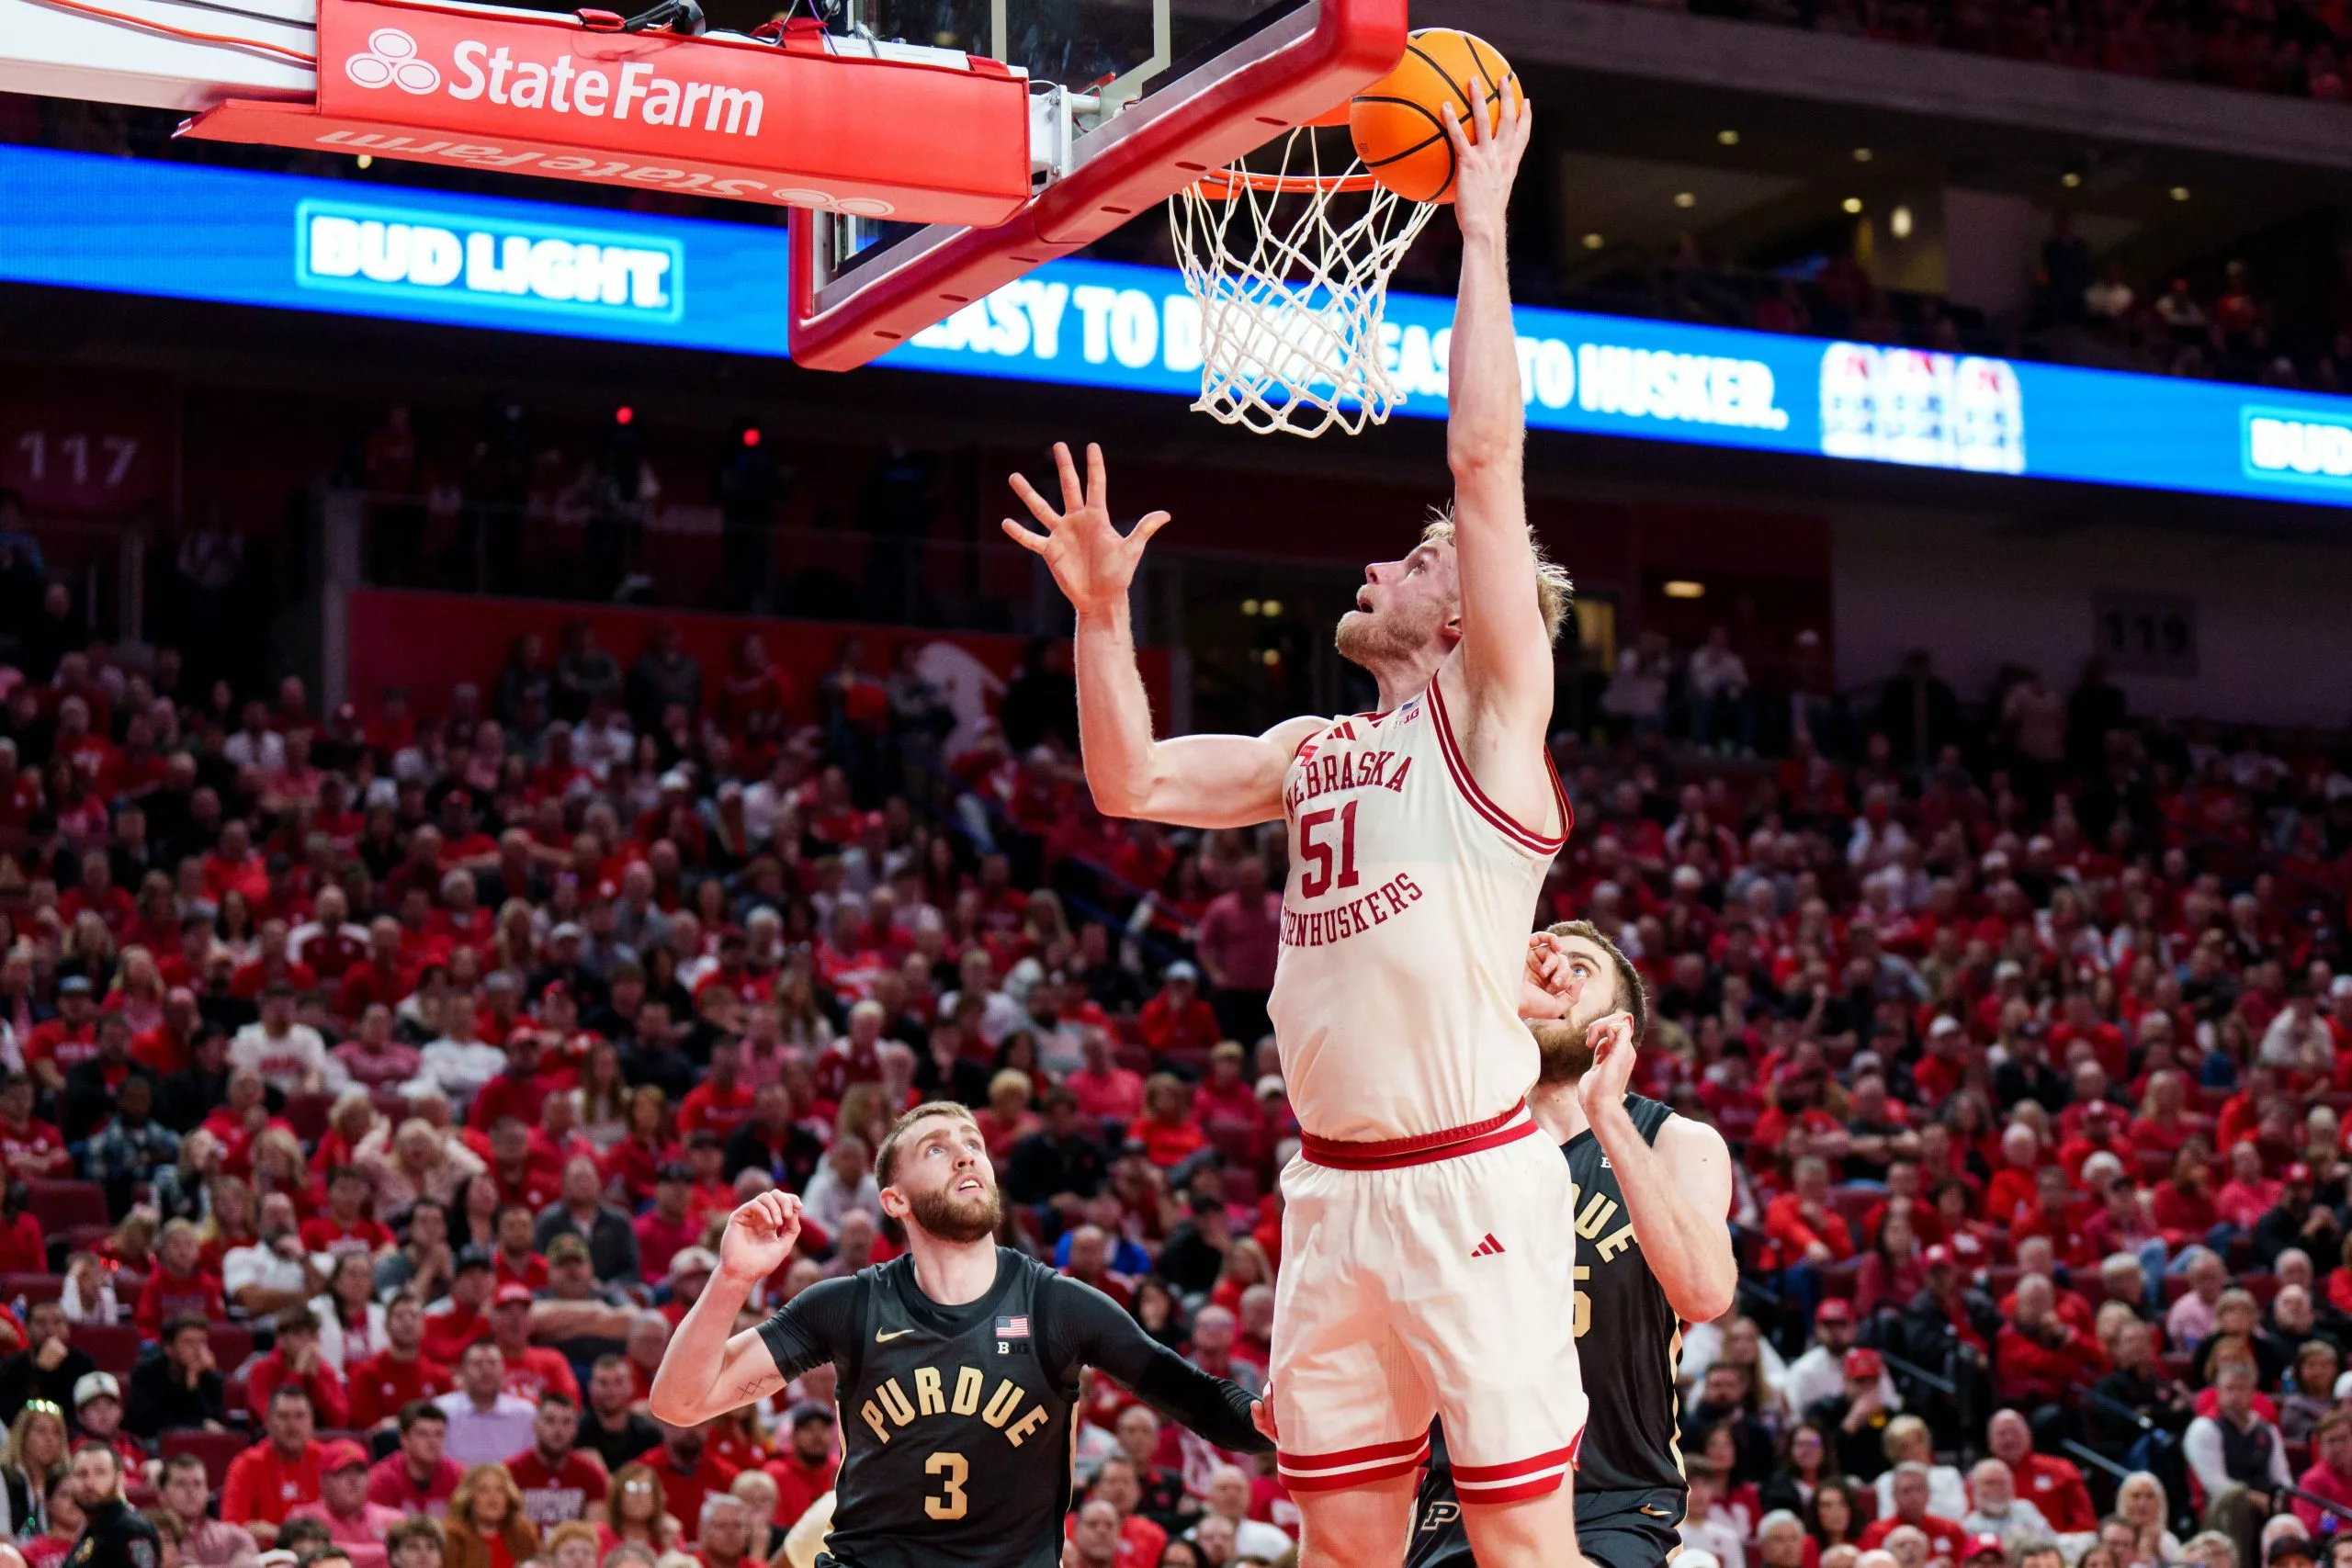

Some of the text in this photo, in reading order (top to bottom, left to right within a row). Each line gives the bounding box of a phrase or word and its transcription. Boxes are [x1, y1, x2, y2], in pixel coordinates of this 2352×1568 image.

[311, 216, 463, 286] BUD
[1072, 285, 1159, 368] TO
[18, 431, 140, 488] 117
[2102, 610, 2190, 658] 119
[1286, 750, 1412, 824] NEBRASKA
[1300, 800, 1359, 899] 51
[860, 1366, 1049, 1449] PURDUE
[924, 1451, 969, 1520] 3
